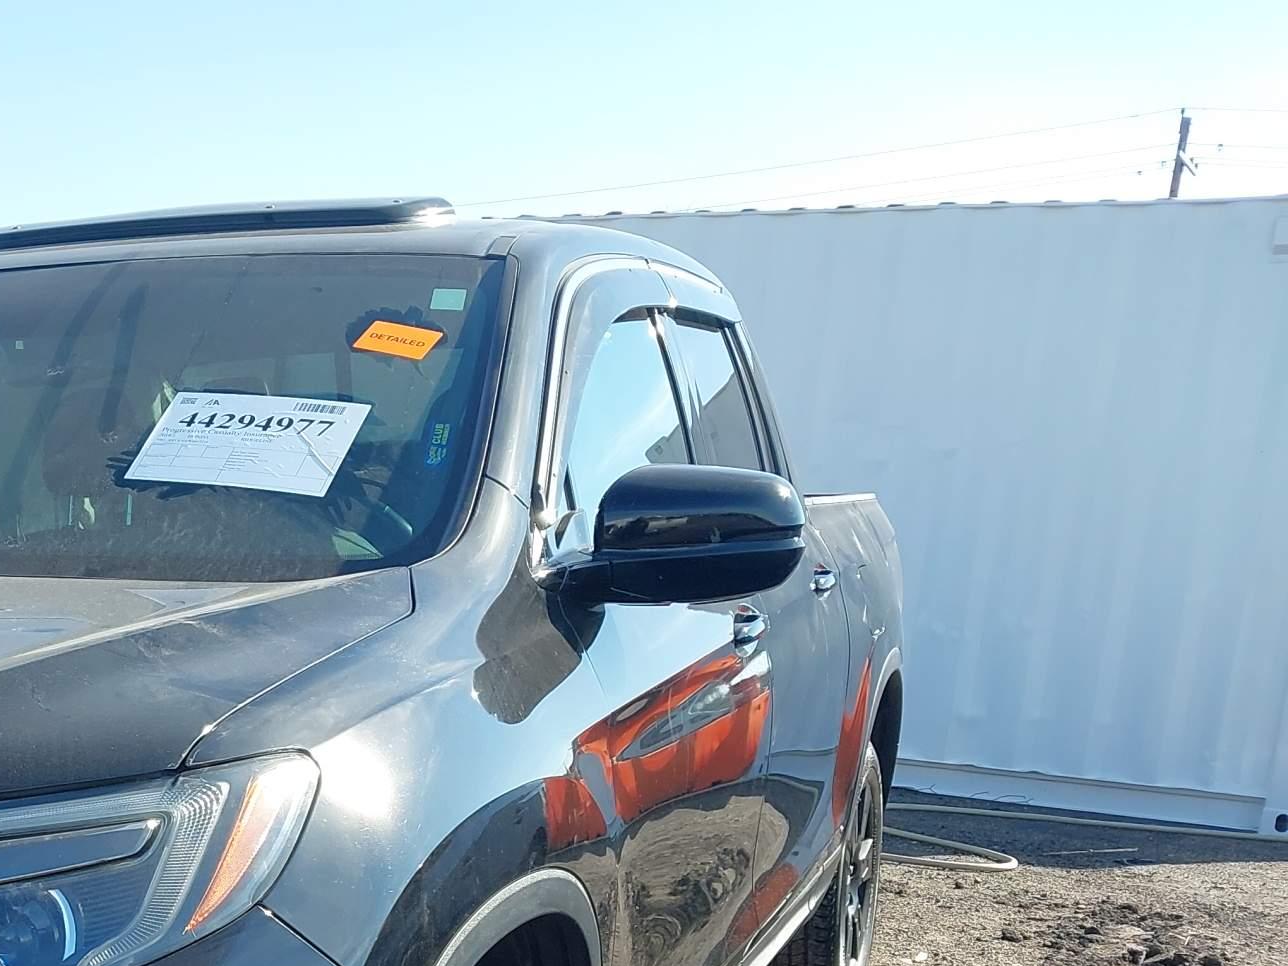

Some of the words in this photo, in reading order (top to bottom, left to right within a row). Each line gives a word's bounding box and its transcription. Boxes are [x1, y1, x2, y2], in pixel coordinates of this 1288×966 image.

[369, 332, 426, 347] DETAILED
[178, 411, 336, 437] 44294977
[432, 423, 444, 445] CLUB
